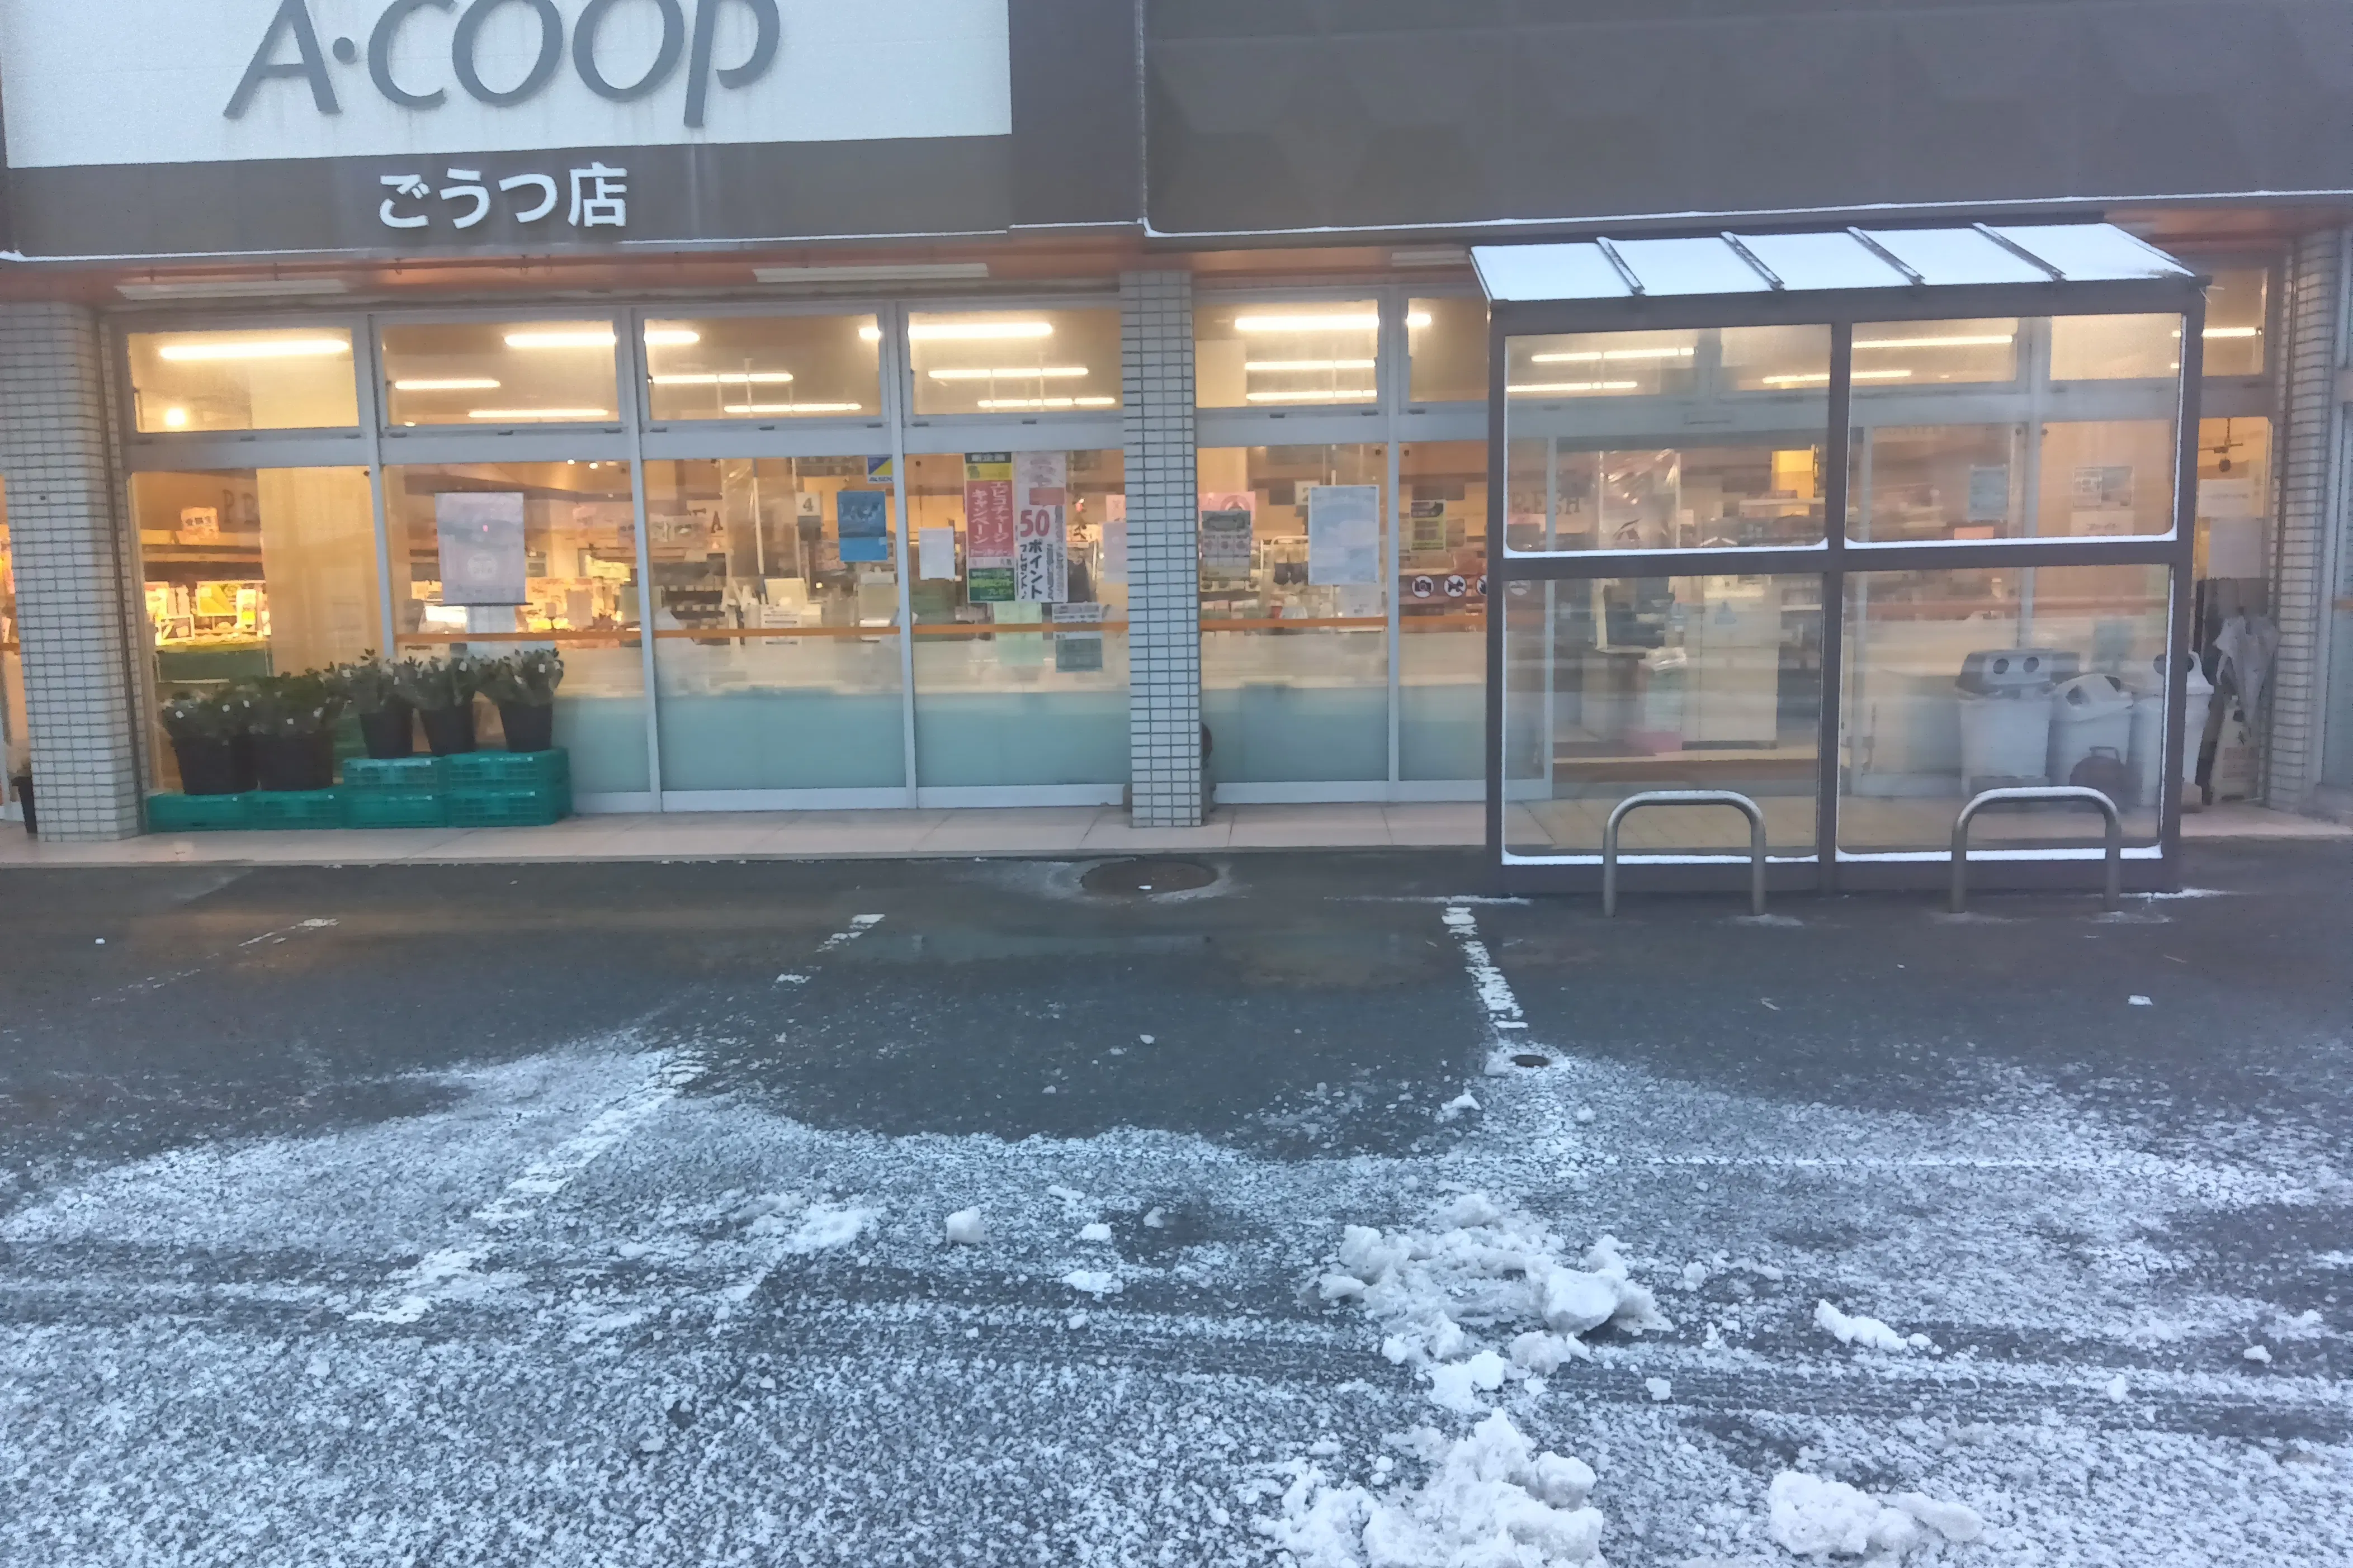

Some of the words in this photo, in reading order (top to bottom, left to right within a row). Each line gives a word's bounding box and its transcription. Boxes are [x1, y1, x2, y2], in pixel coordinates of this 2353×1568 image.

[379, 162, 627, 228] ごうつ店
[802, 498, 814, 512] 4
[1020, 509, 1050, 537] 50
[1028, 539, 1043, 599] ポイント
